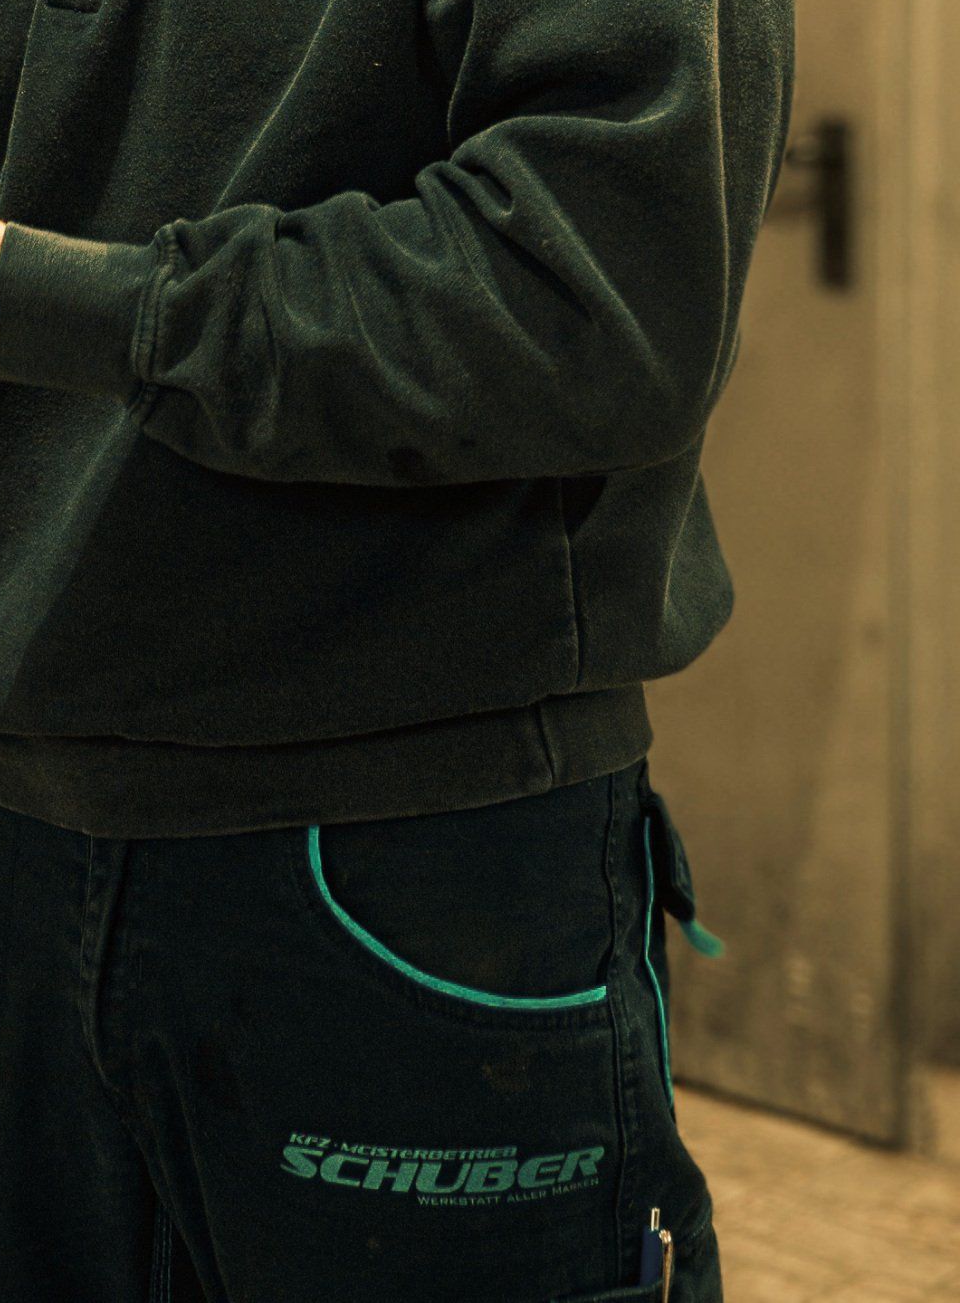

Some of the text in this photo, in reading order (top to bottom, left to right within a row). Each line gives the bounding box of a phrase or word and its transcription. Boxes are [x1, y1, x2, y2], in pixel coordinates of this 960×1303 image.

[289, 1133, 331, 1147] KFZ
[280, 1146, 605, 1194] SCHUBER
[417, 1195, 501, 1207] WERKSTATT
[506, 1190, 547, 1203] ALLER
